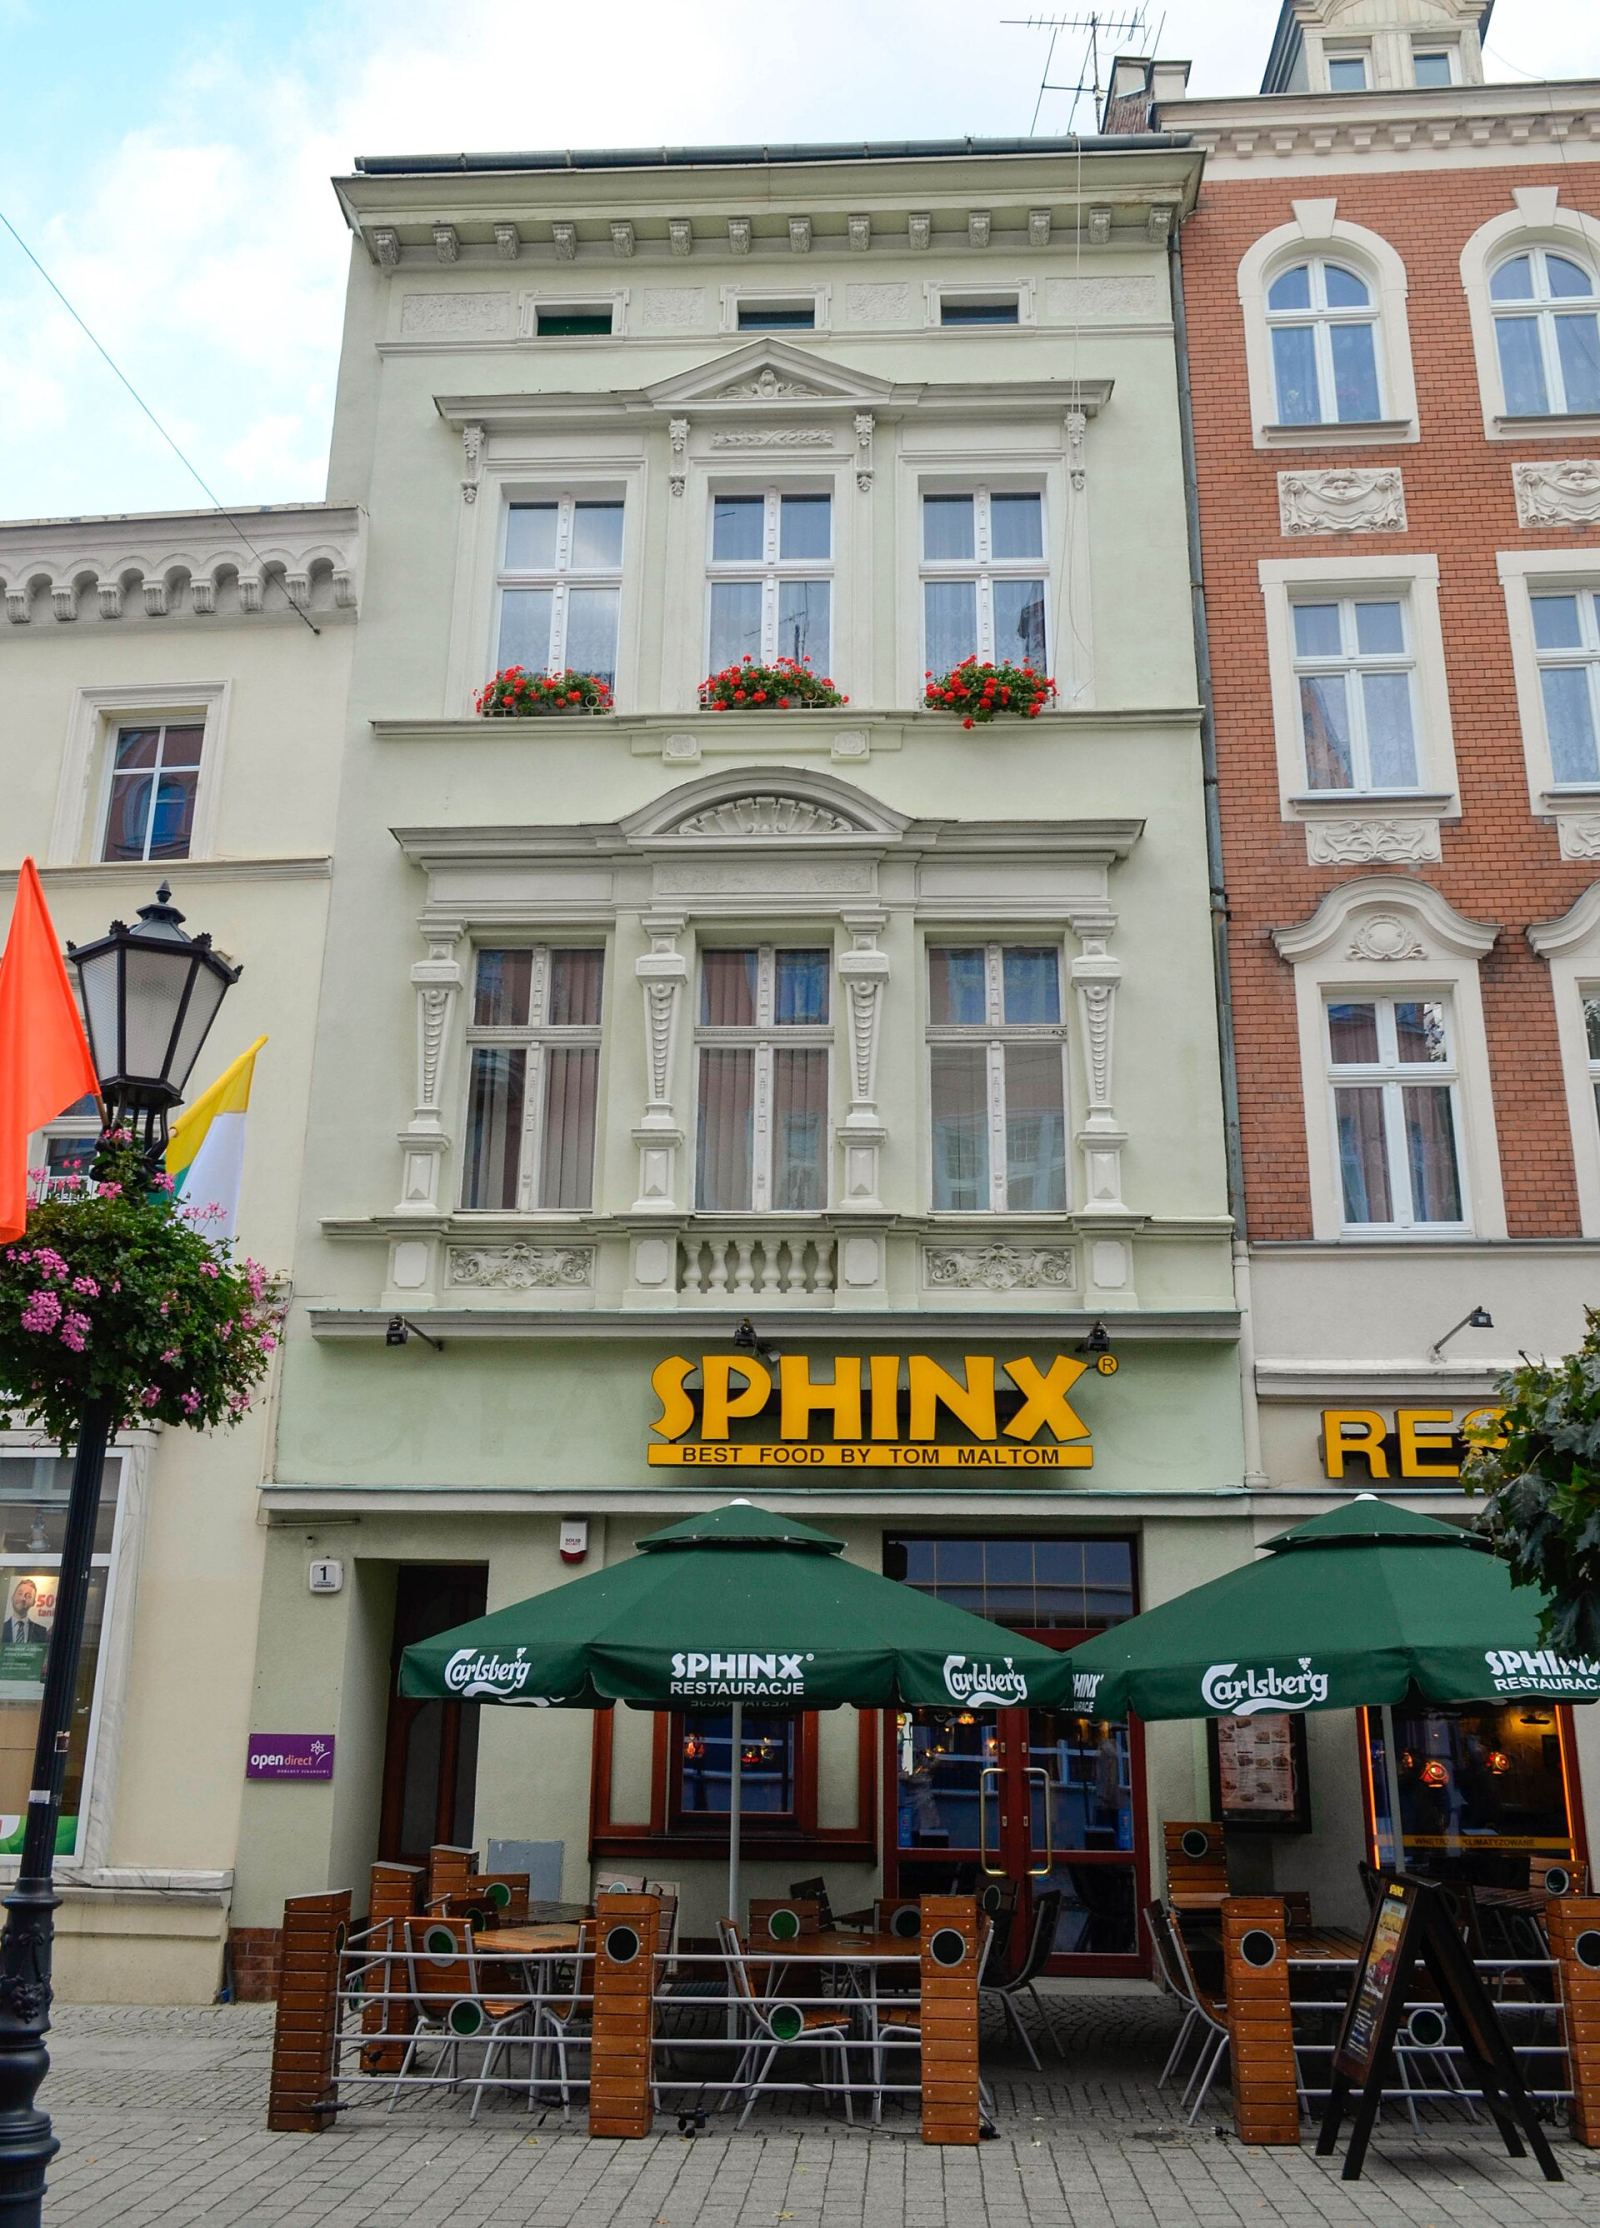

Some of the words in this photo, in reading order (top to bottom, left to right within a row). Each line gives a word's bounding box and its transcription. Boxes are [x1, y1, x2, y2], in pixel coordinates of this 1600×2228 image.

[648, 1354, 1093, 1443] SPHINX
[682, 1447, 743, 1463] BEST
[759, 1448, 825, 1464] FOOD
[840, 1448, 871, 1464] BY
[888, 1448, 940, 1464] TOM
[957, 1448, 1060, 1465] MALTOM
[319, 1565, 327, 1581] 1
[444, 1648, 532, 1692] Carlsberg
[671, 1652, 804, 1679] SPHINX
[670, 1681, 804, 1695] RESTAURACJE
[943, 1655, 1028, 1702] Carlsberg
[1201, 1662, 1329, 1710] Carlsberg
[1494, 1676, 1600, 1691] RESTAURAC
[250, 1754, 283, 1770] open
[284, 1754, 312, 1766] direct
